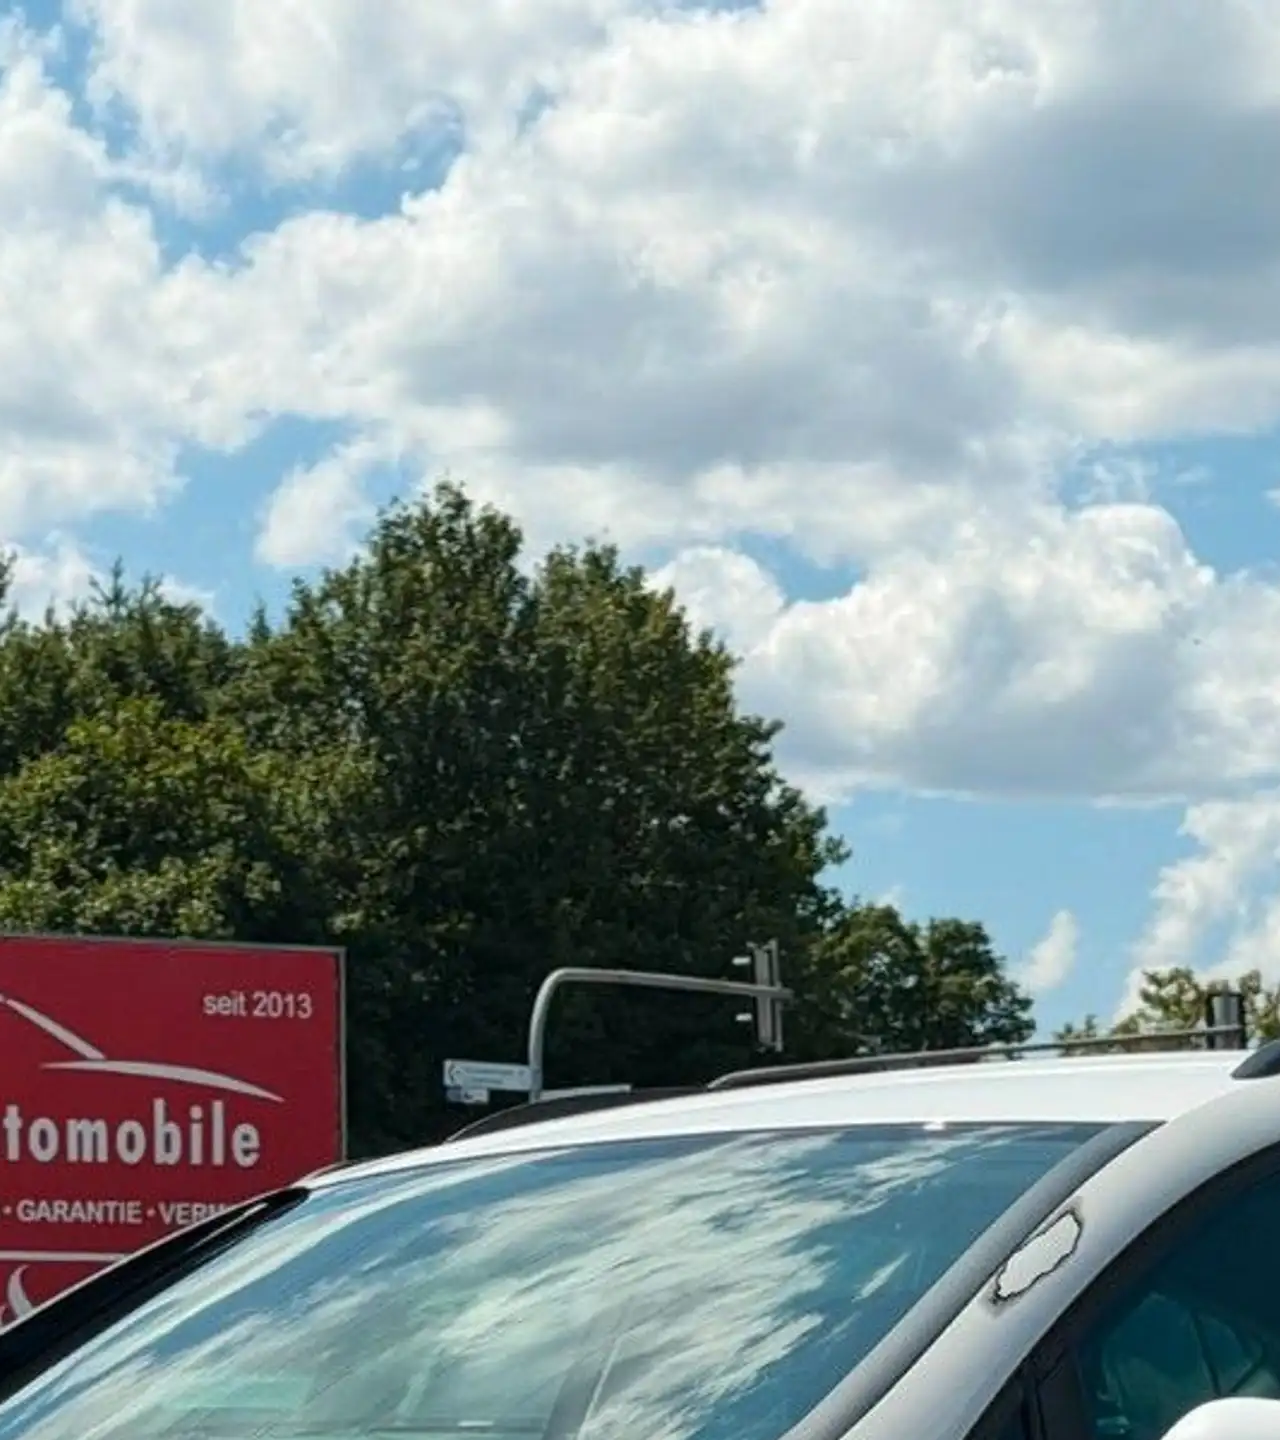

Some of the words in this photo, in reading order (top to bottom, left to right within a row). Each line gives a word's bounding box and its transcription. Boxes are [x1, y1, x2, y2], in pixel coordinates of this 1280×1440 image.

[203, 990, 247, 1016] seit
[252, 991, 313, 1019] 2013
[17, 1200, 142, 1224] GARANTIE
